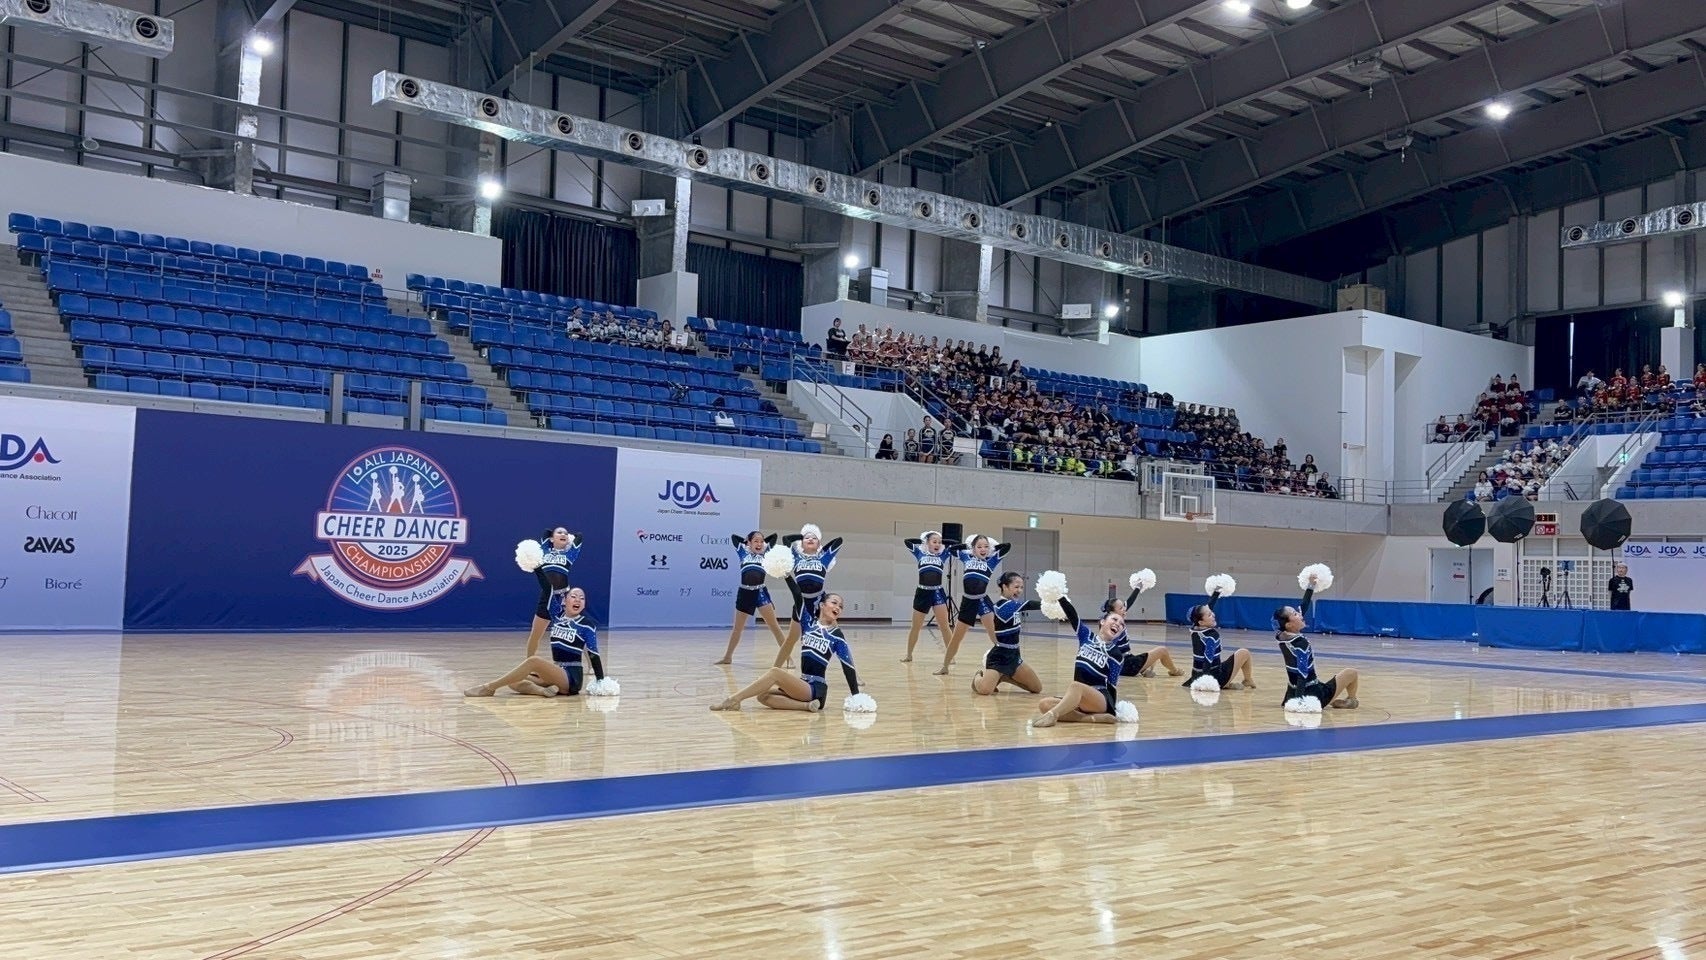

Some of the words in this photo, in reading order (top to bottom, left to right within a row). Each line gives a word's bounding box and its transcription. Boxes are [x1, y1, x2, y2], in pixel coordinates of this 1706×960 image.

[365, 453, 386, 470] ALL
[390, 451, 432, 475] JAPAN
[19, 473, 62, 481] Association
[658, 479, 721, 509] JCDA
[25, 504, 78, 521] Chacott
[323, 515, 386, 538] CHEER
[393, 518, 460, 540] DANCE
[649, 533, 683, 542] POMCHE
[23, 536, 76, 554] SAVAS
[377, 545, 409, 556] 2025
[1624, 544, 1652, 556] JCDA
[1658, 545, 1687, 557] JCDA
[346, 545, 438, 579] CHAMPIONSHIP
[699, 557, 729, 570] SAVAS
[45, 577, 83, 590] Bioré
[320, 565, 345, 590] Japan
[345, 583, 376, 602] Cheer
[377, 592, 409, 604] Dance
[411, 569, 460, 601] Association
[636, 587, 660, 597] Skater
